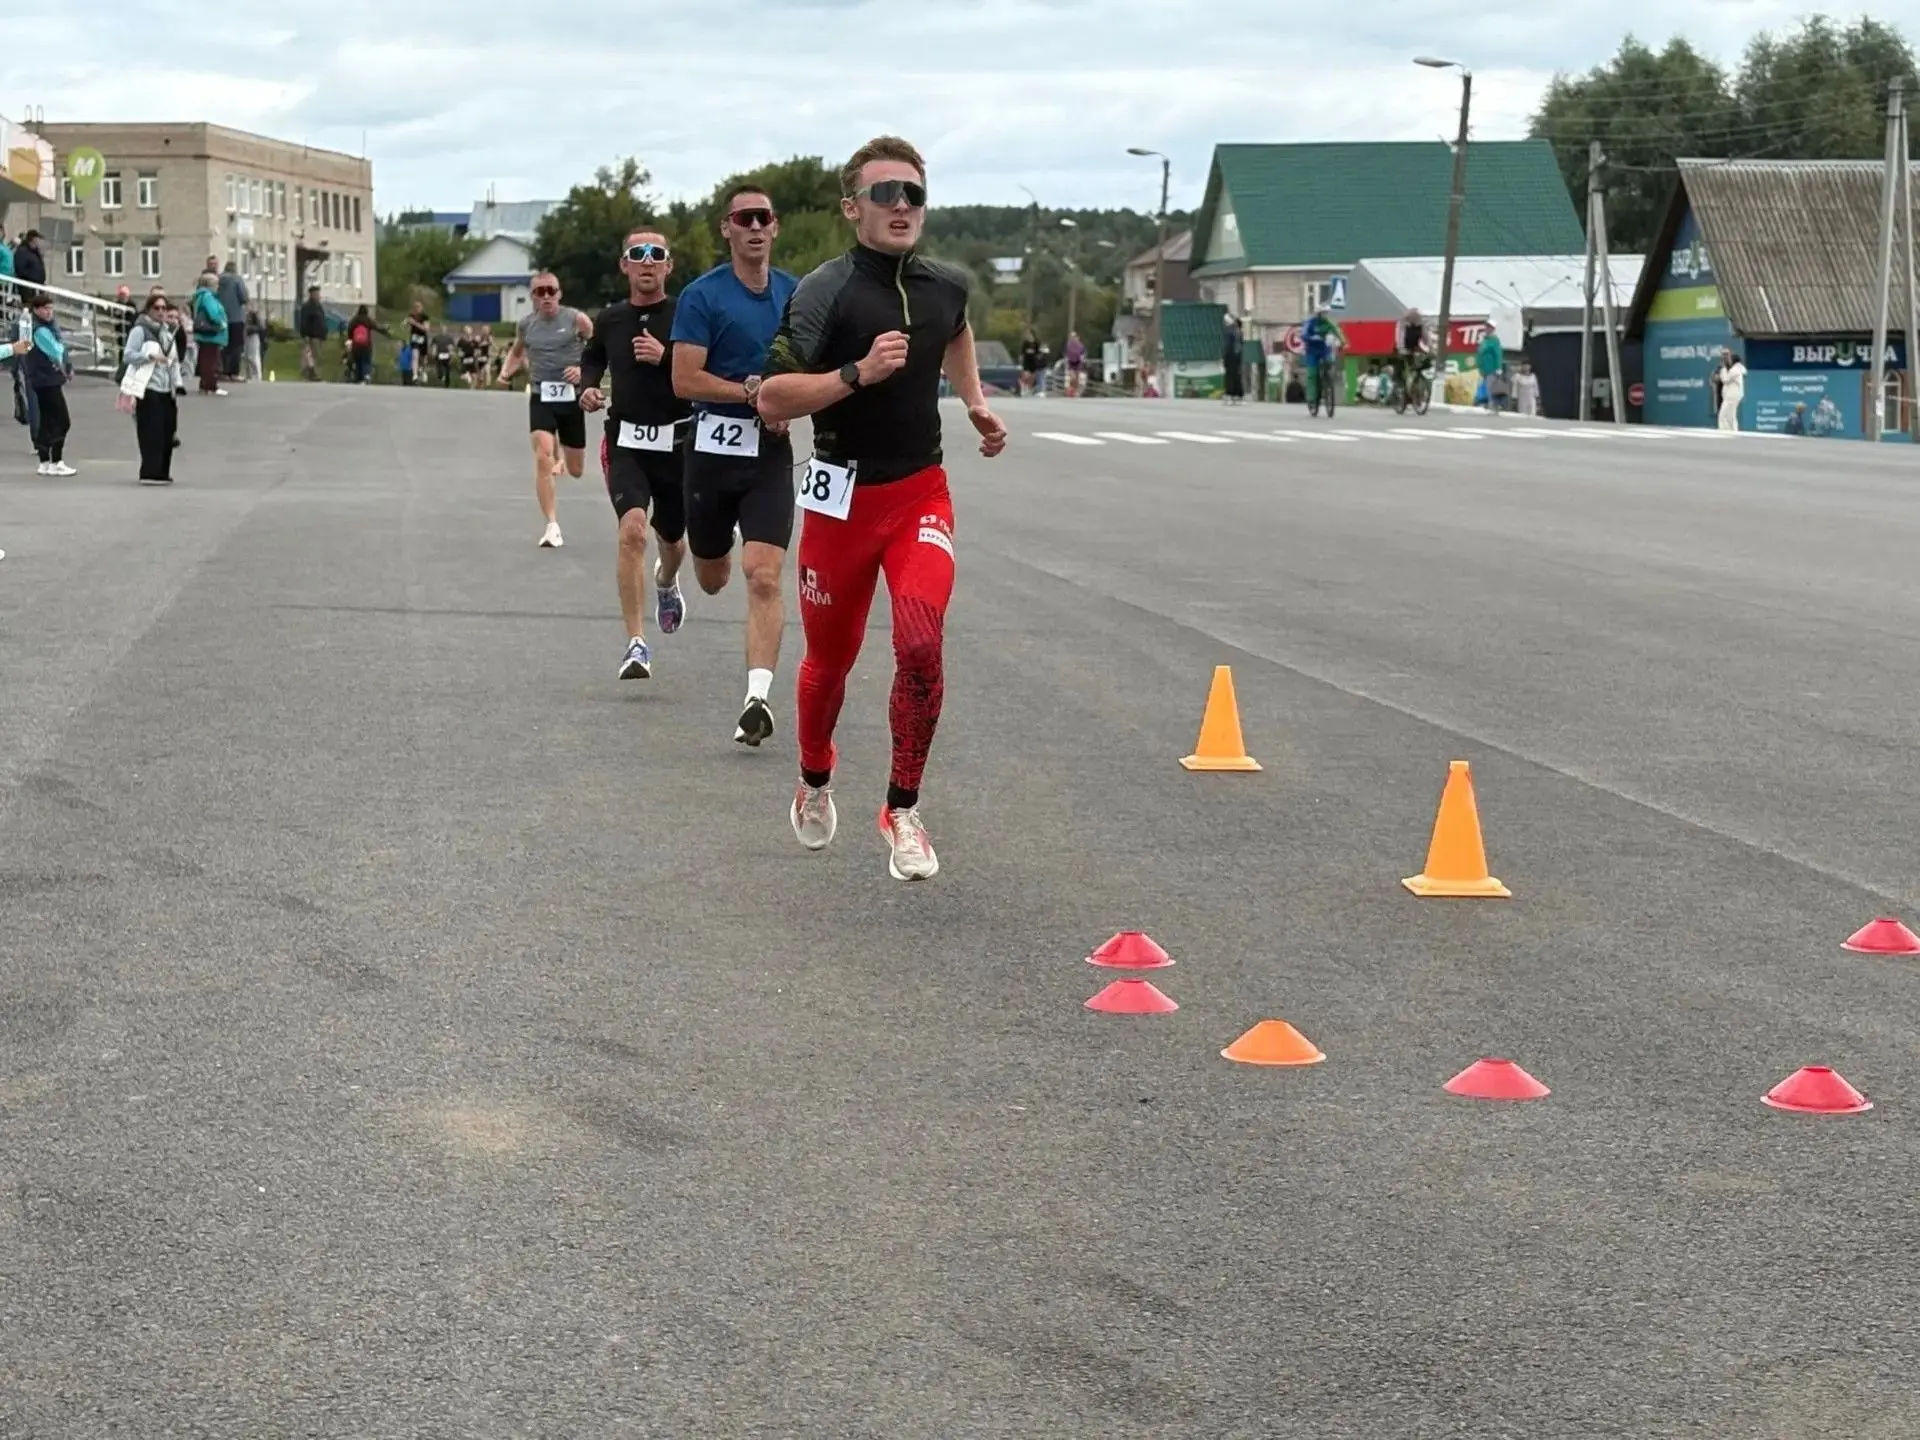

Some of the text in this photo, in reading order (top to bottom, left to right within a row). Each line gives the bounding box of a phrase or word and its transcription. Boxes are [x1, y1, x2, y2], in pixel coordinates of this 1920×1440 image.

[549, 384, 566, 397] 37
[633, 424, 659, 442] 50
[710, 422, 743, 447] 42
